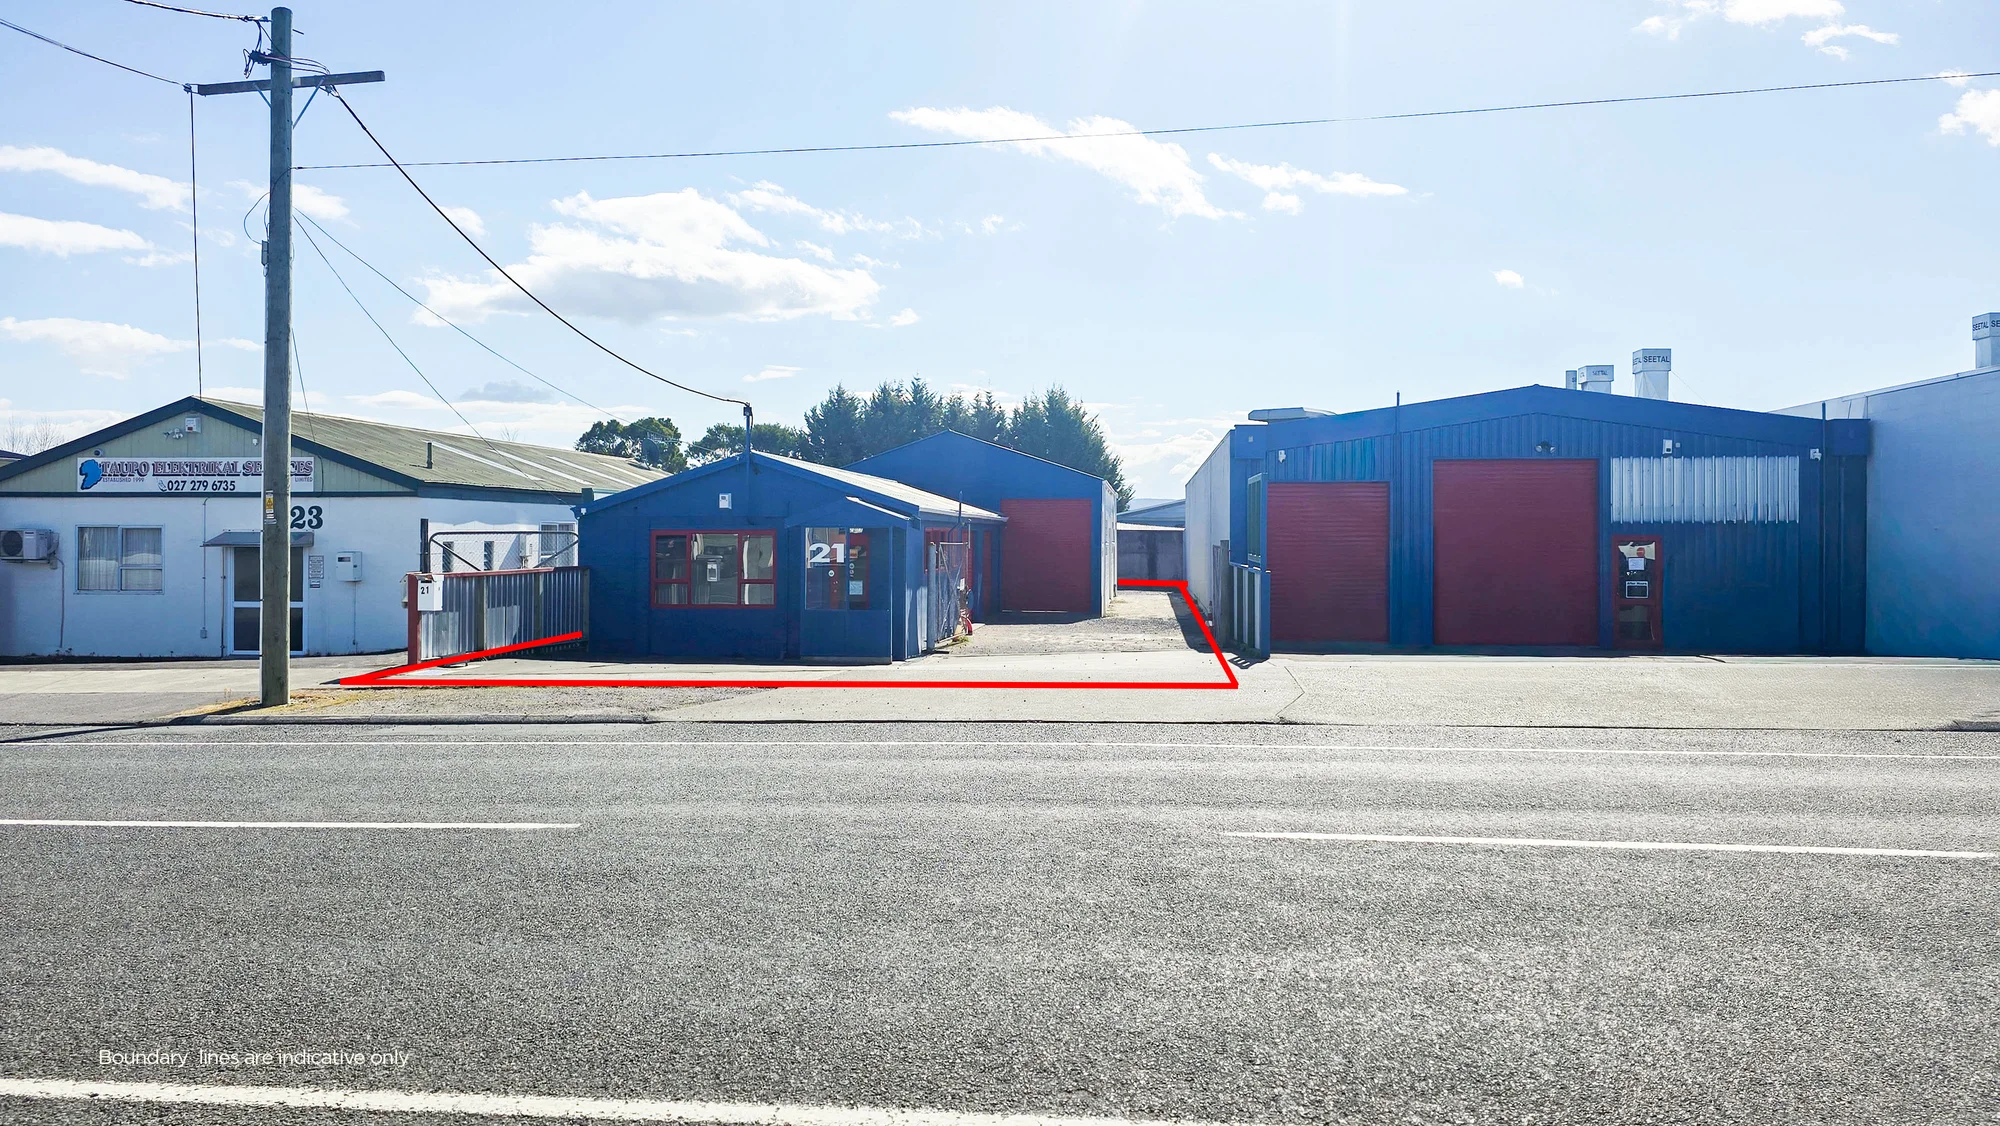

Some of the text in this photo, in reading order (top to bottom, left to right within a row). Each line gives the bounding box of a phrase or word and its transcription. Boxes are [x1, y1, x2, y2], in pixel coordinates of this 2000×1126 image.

[1972, 321, 1989, 331] SEETAL
[1643, 355, 1670, 363] SEETAL
[101, 461, 150, 477] TAUPO
[152, 461, 241, 477] ELEKTRIKAL
[167, 480, 236, 491] 027 279 6735
[290, 505, 323, 530] 23
[809, 543, 845, 563] 21
[420, 586, 429, 595] 21
